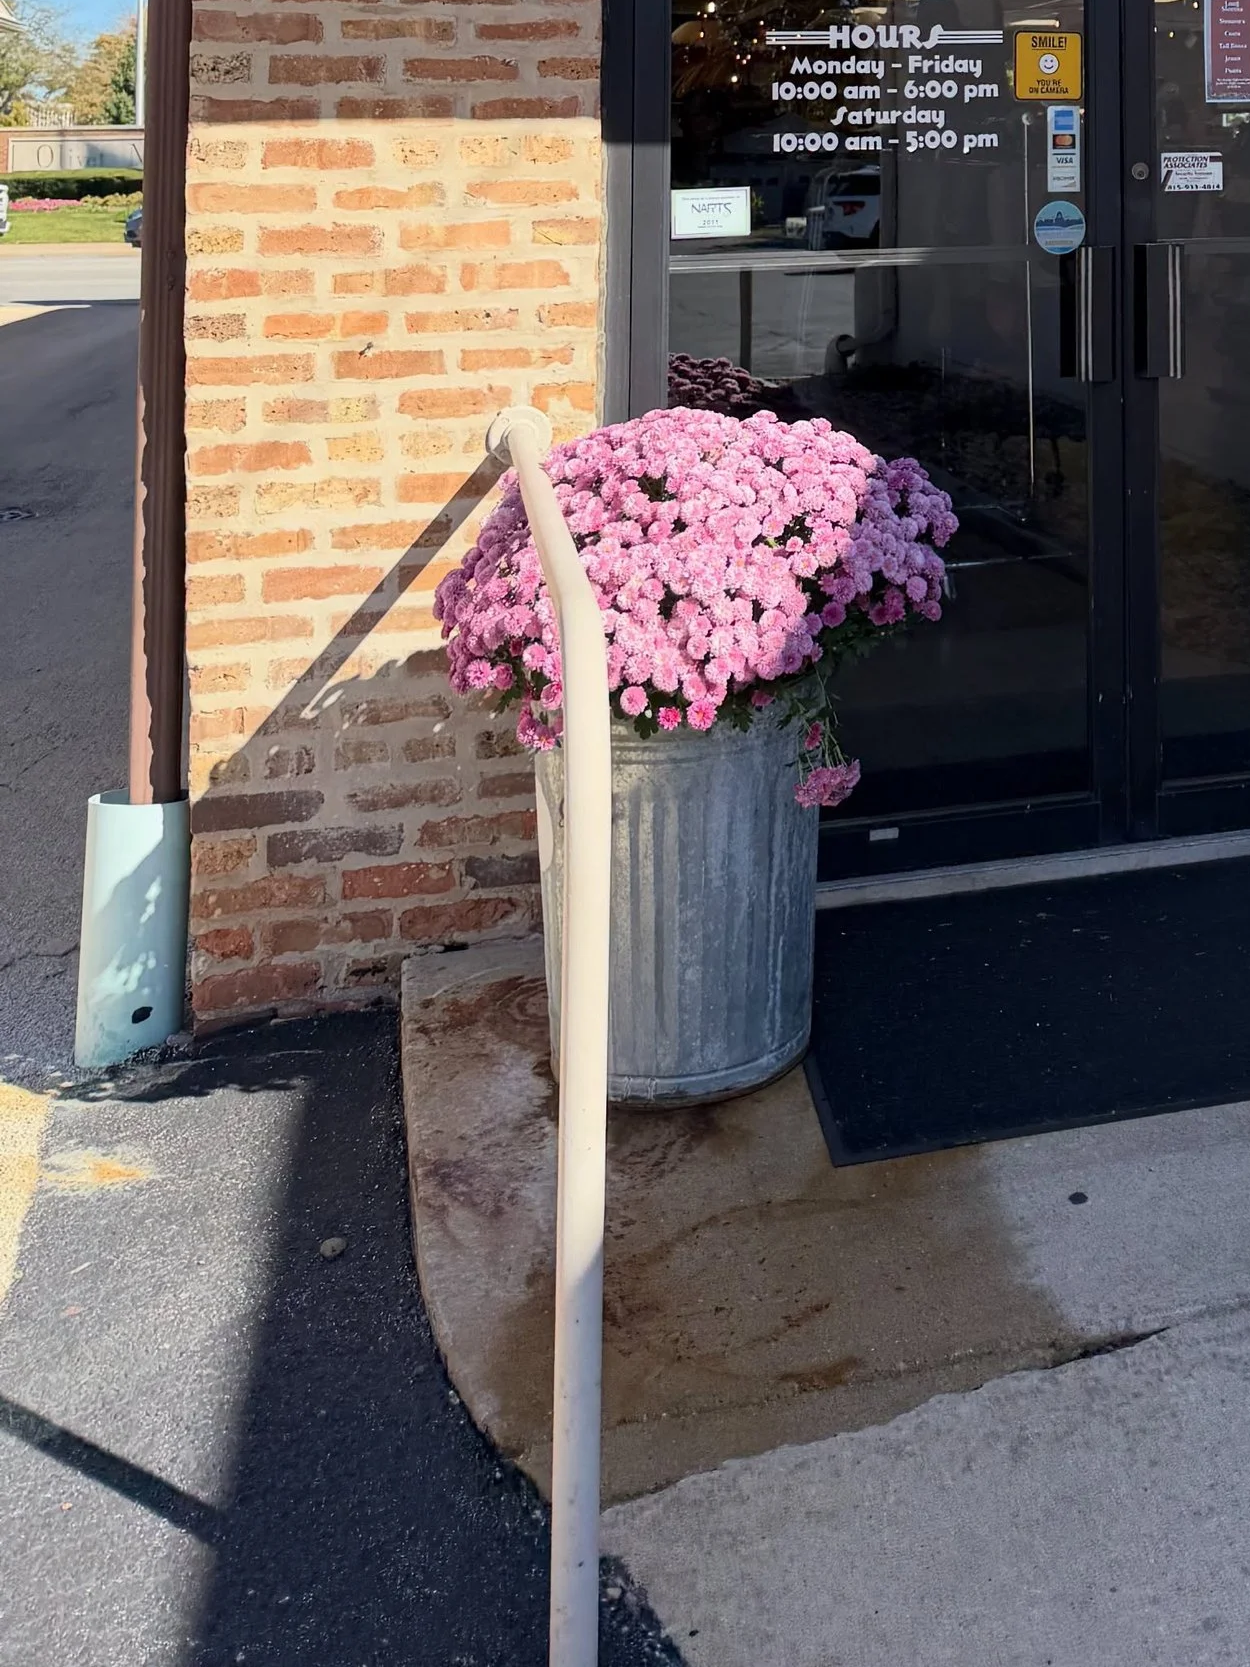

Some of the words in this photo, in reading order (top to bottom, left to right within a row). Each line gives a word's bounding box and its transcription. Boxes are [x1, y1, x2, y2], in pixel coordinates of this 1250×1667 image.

[829, 24, 944, 50] HOURS
[1031, 36, 1067, 48] SMILE!
[790, 56, 885, 79] Monday
[908, 55, 982, 78] Friday
[772, 81, 837, 101] 10:00
[843, 85, 881, 100] am
[904, 79, 958, 100] 6:00
[963, 82, 999, 103] pm
[1040, 86, 1069, 94] CAMERA
[830, 106, 945, 129] Saturday
[773, 132, 838, 152] 10:00
[844, 135, 882, 151] am
[905, 130, 959, 152] 5:00
[963, 133, 999, 154] pm
[691, 203, 732, 214] NARTS
